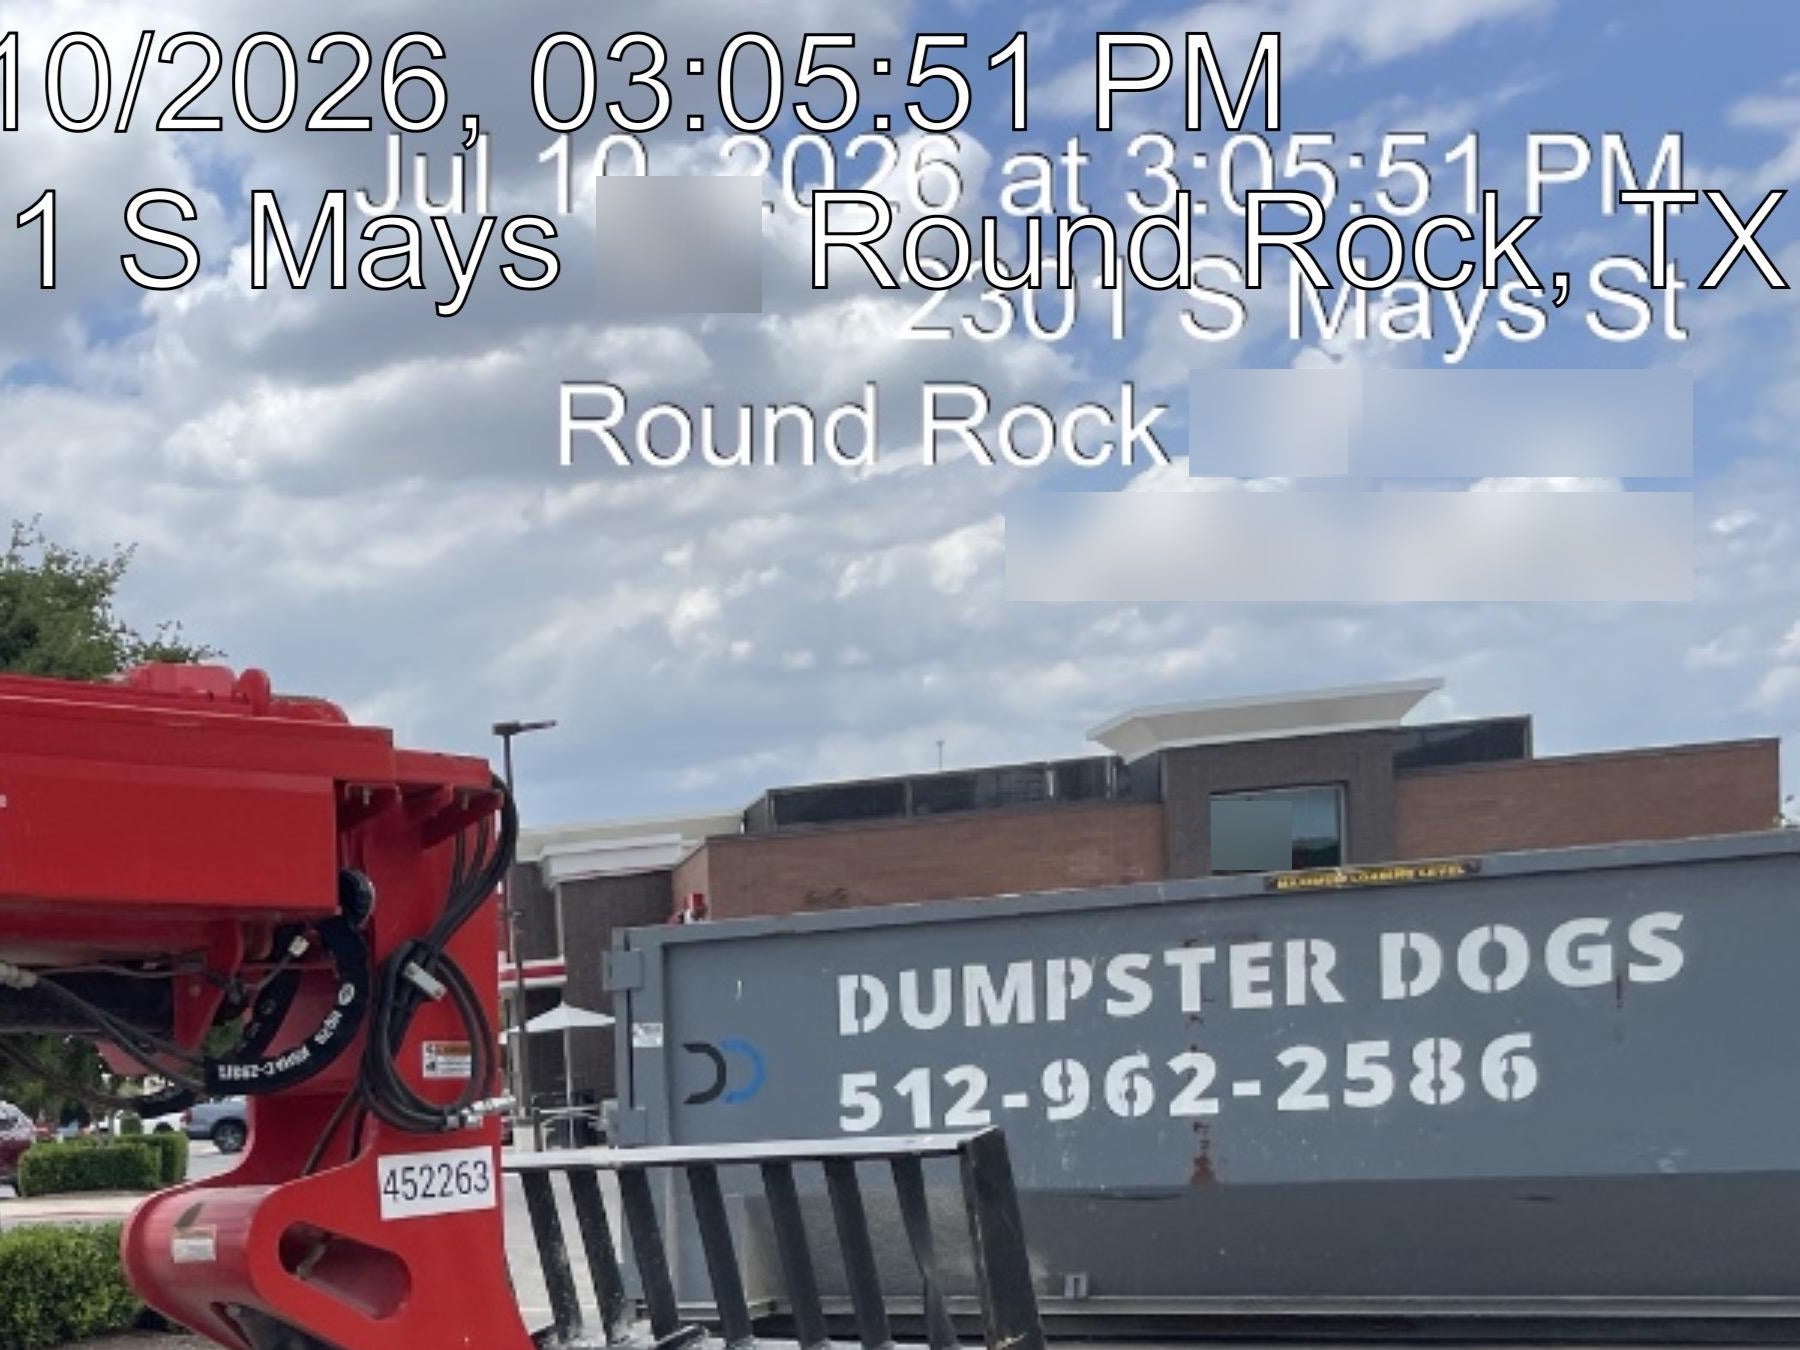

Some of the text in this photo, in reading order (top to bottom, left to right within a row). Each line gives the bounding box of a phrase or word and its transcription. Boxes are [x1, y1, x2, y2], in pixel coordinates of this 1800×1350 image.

[836, 910, 1686, 1035] DUMPSTER DOGS
[837, 1031, 1539, 1133] 512-962-2586
[383, 1160, 491, 1202] 452263
